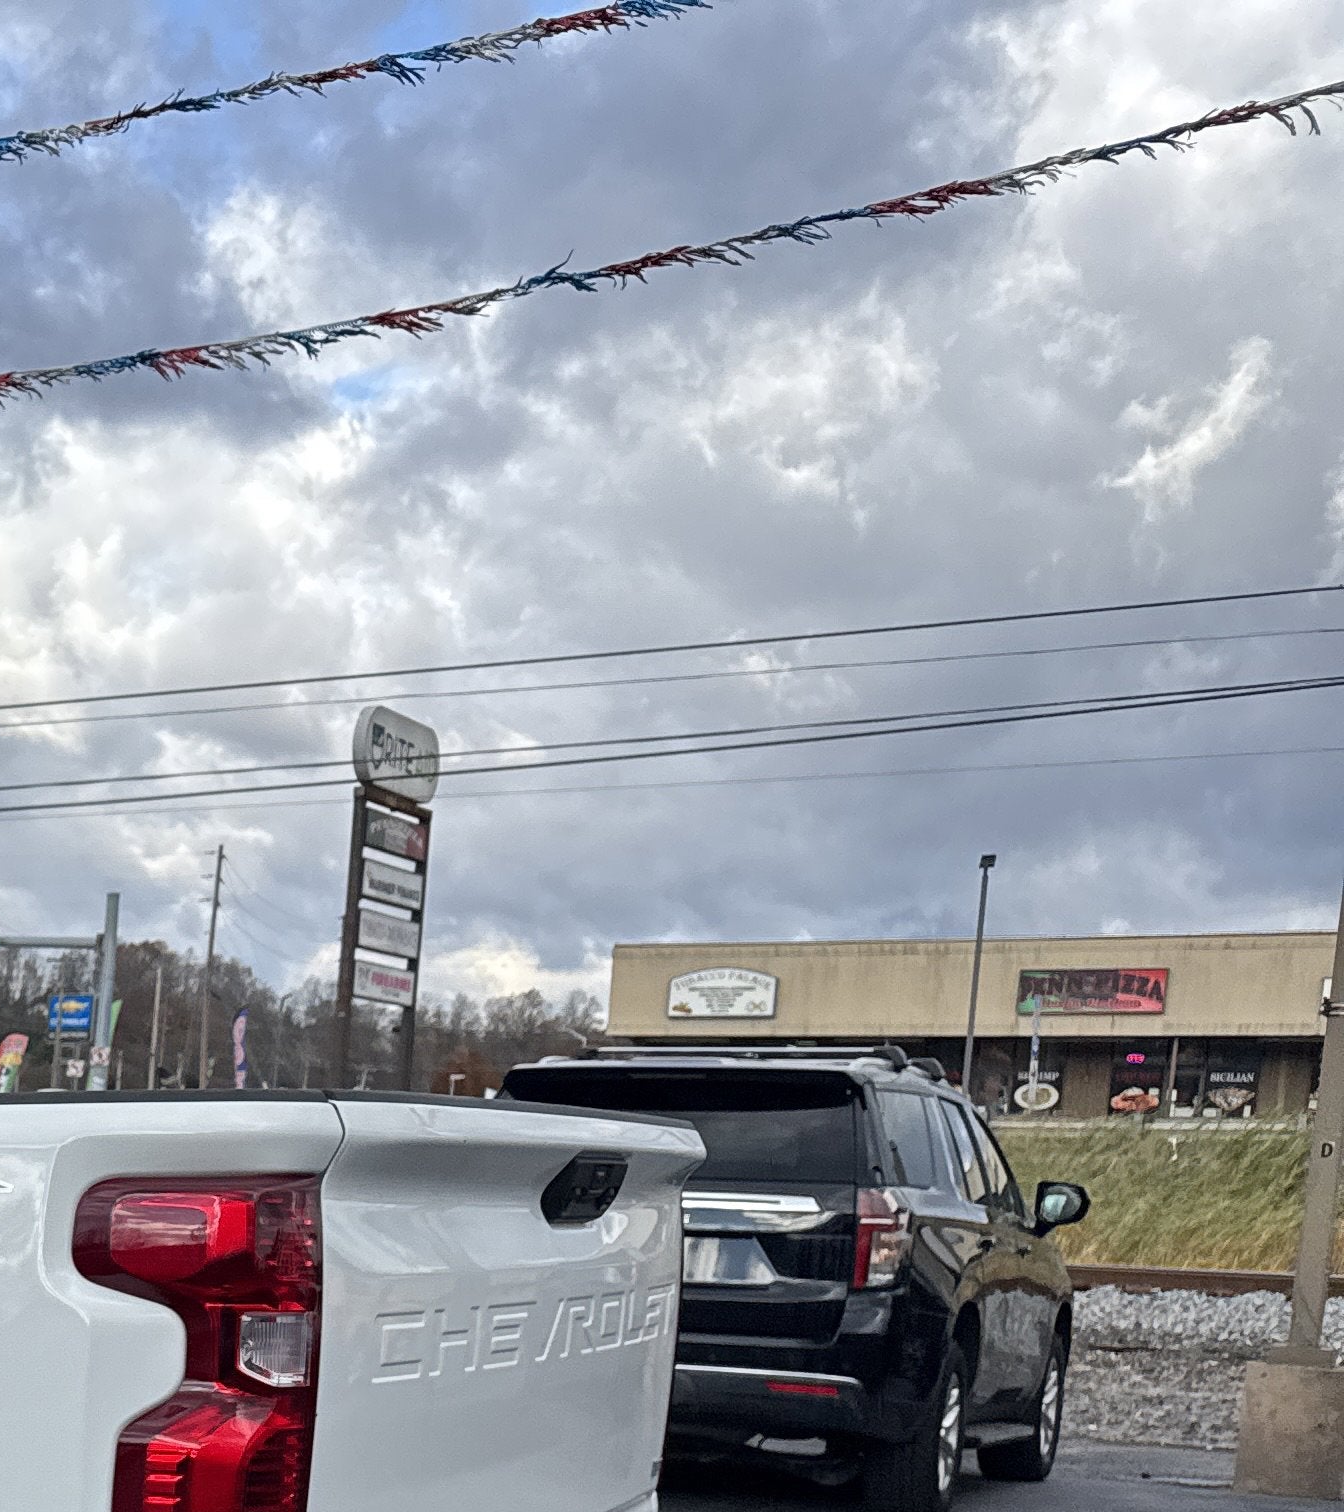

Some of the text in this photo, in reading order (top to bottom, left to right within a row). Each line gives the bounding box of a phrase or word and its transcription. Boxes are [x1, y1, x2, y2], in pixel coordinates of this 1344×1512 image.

[382, 732, 415, 776] RITE
[1209, 1072, 1255, 1083] SICILIAN
[1321, 1143, 1333, 1157] D
[372, 1283, 676, 1384] CHEVROLET
